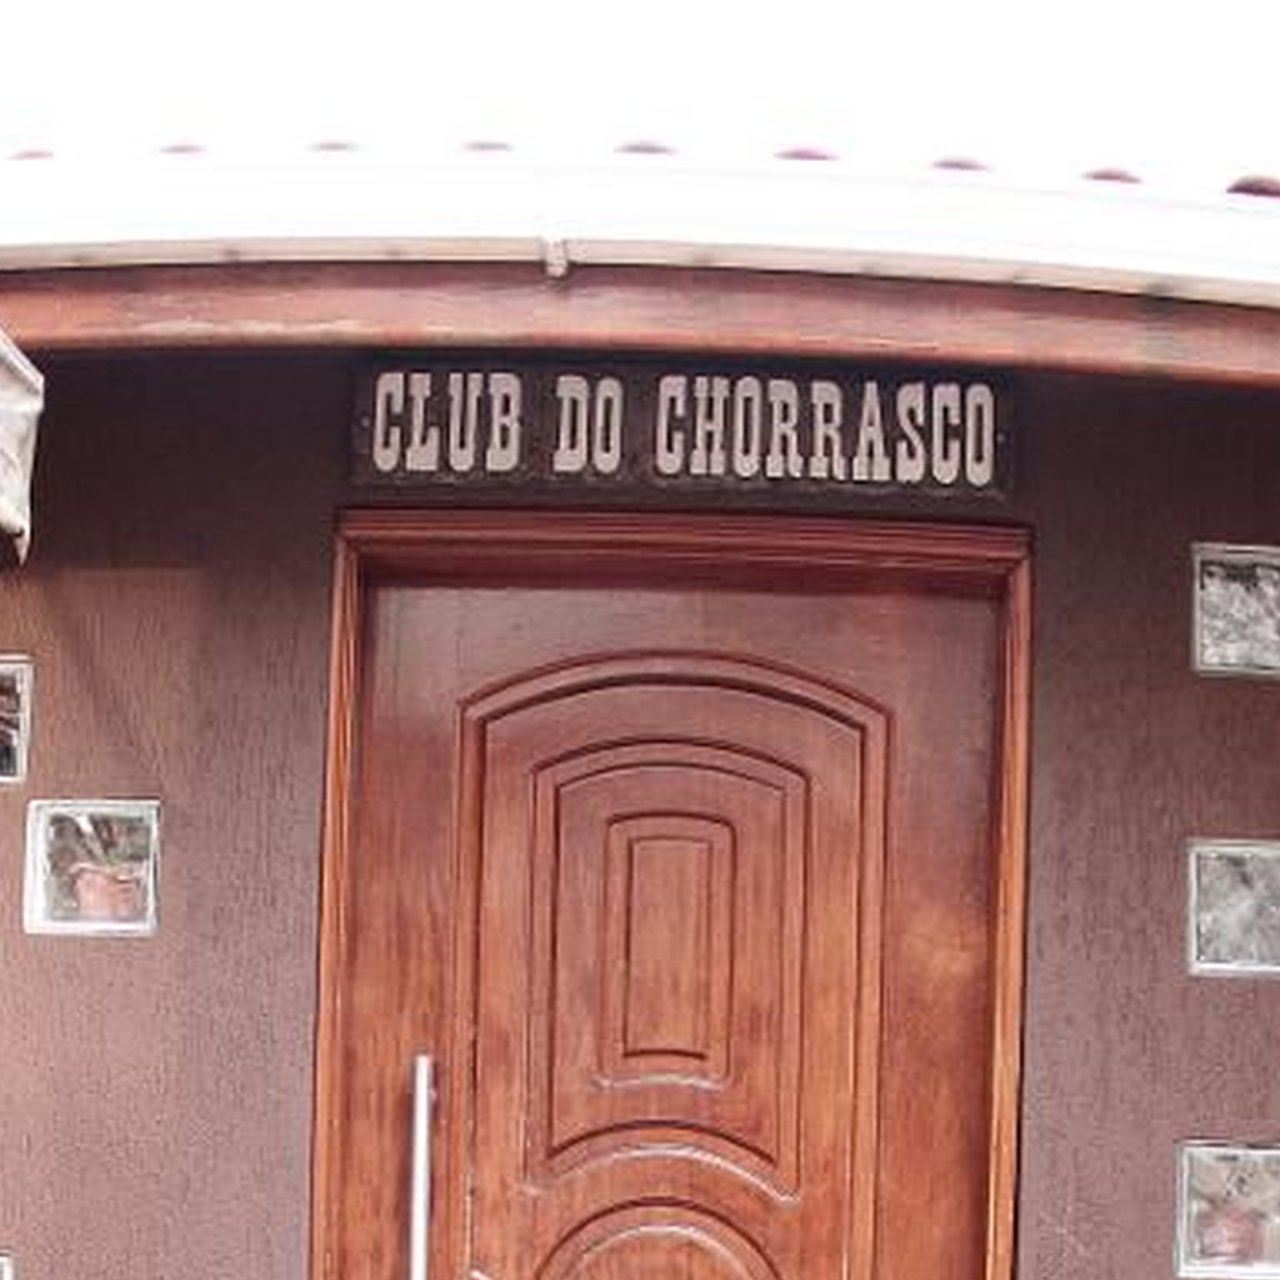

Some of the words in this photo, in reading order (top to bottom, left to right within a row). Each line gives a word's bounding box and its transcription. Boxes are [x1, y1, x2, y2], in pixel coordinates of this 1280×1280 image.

[373, 373, 522, 472] CLUB
[553, 375, 623, 473] DO
[655, 375, 995, 486] CHORRASCO
